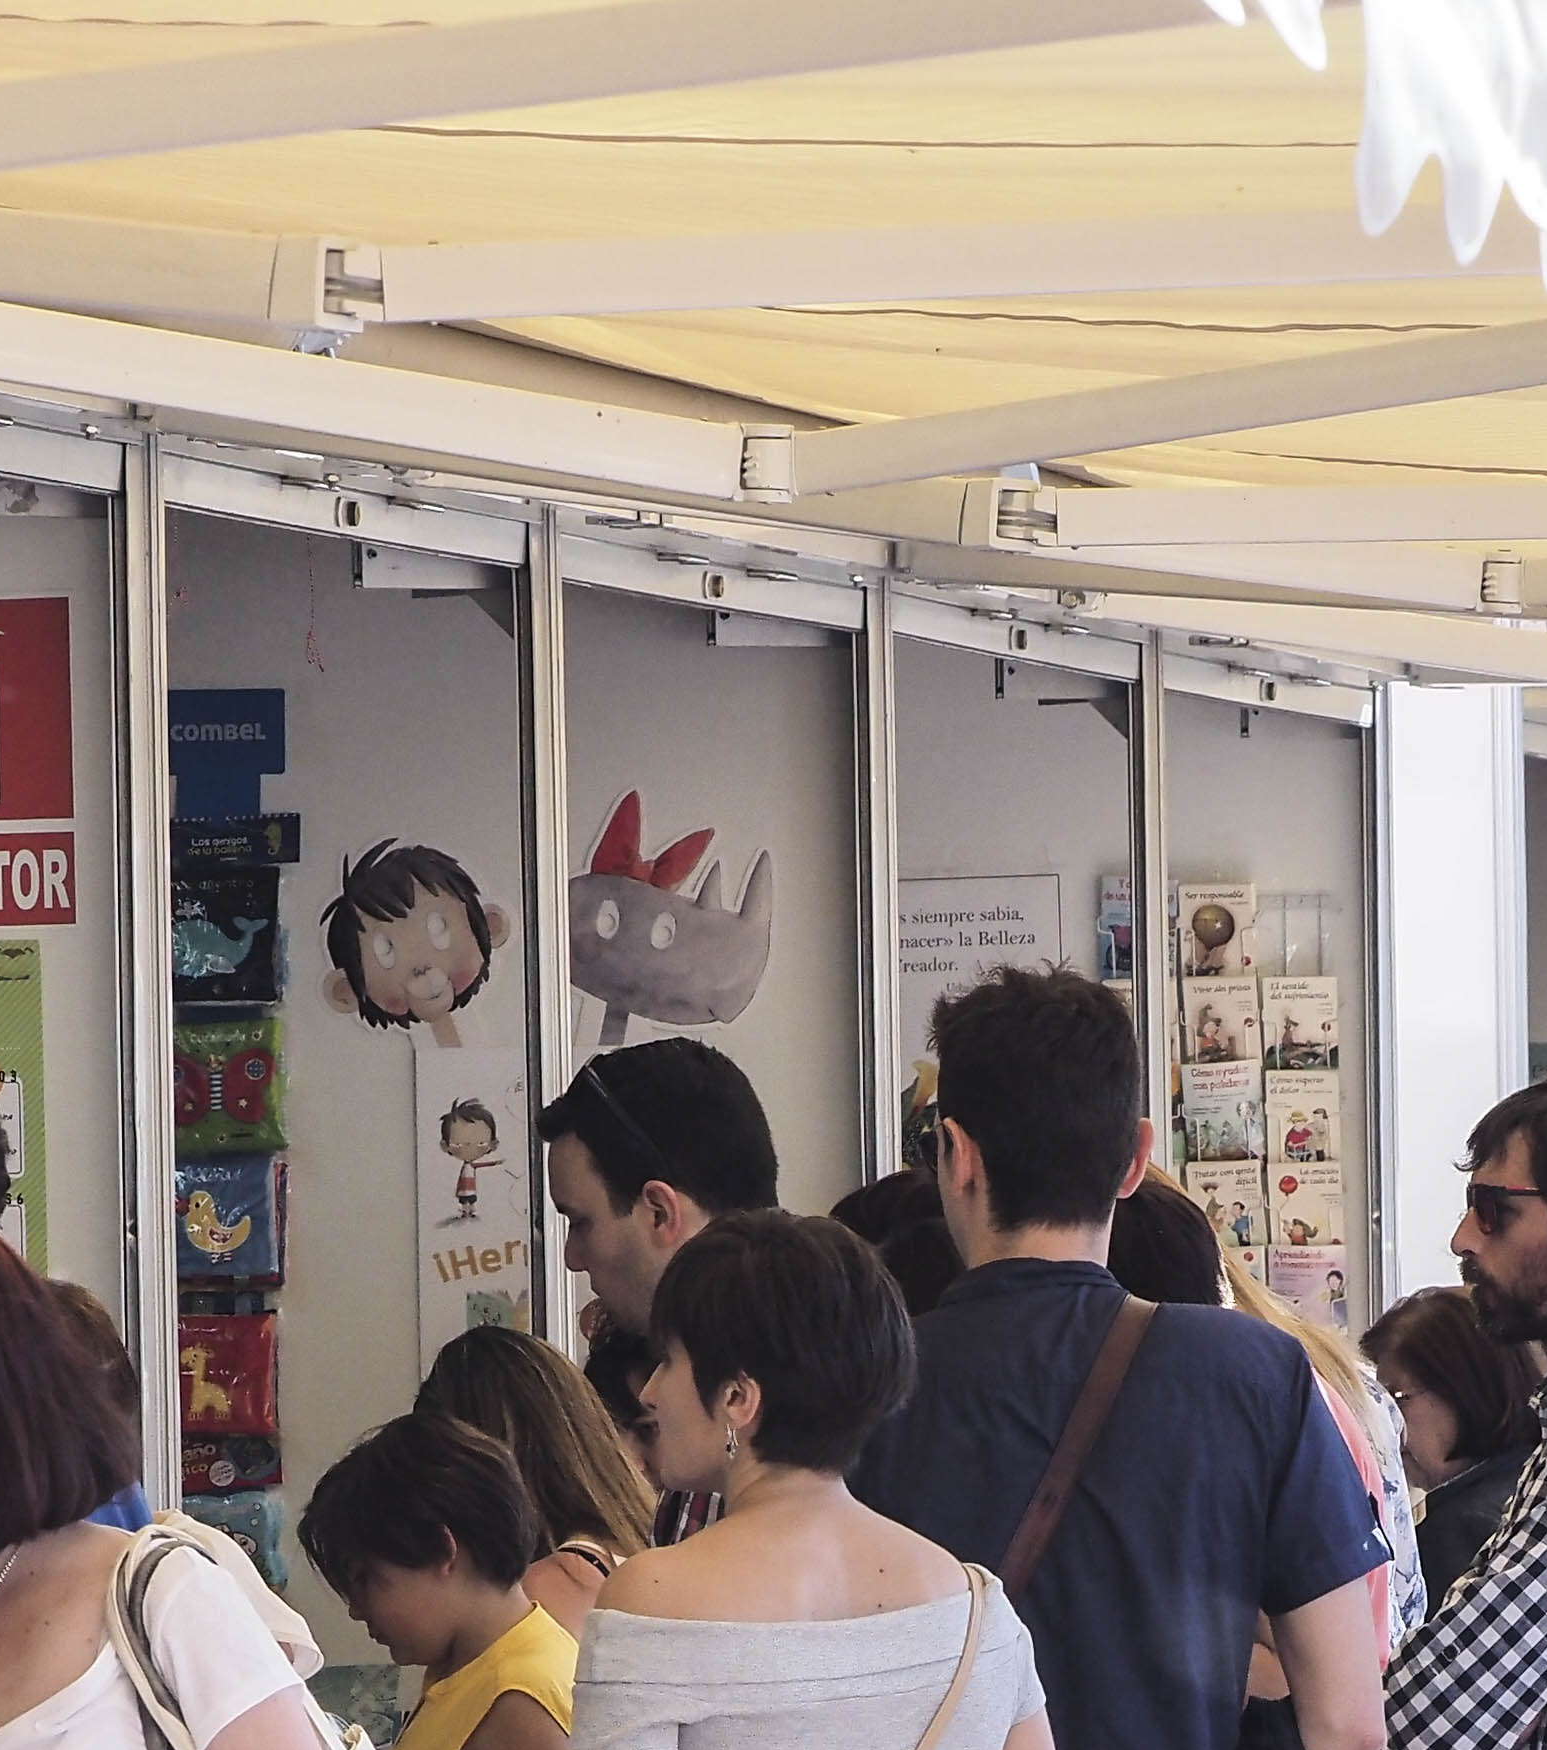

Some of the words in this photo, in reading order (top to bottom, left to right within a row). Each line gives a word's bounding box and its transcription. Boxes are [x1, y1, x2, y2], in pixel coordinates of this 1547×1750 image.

[912, 906, 975, 928] siempre
[979, 906, 1024, 923] sabia,
[958, 931, 973, 947] la
[978, 928, 1036, 946] Belleza
[898, 956, 959, 973] reador.
